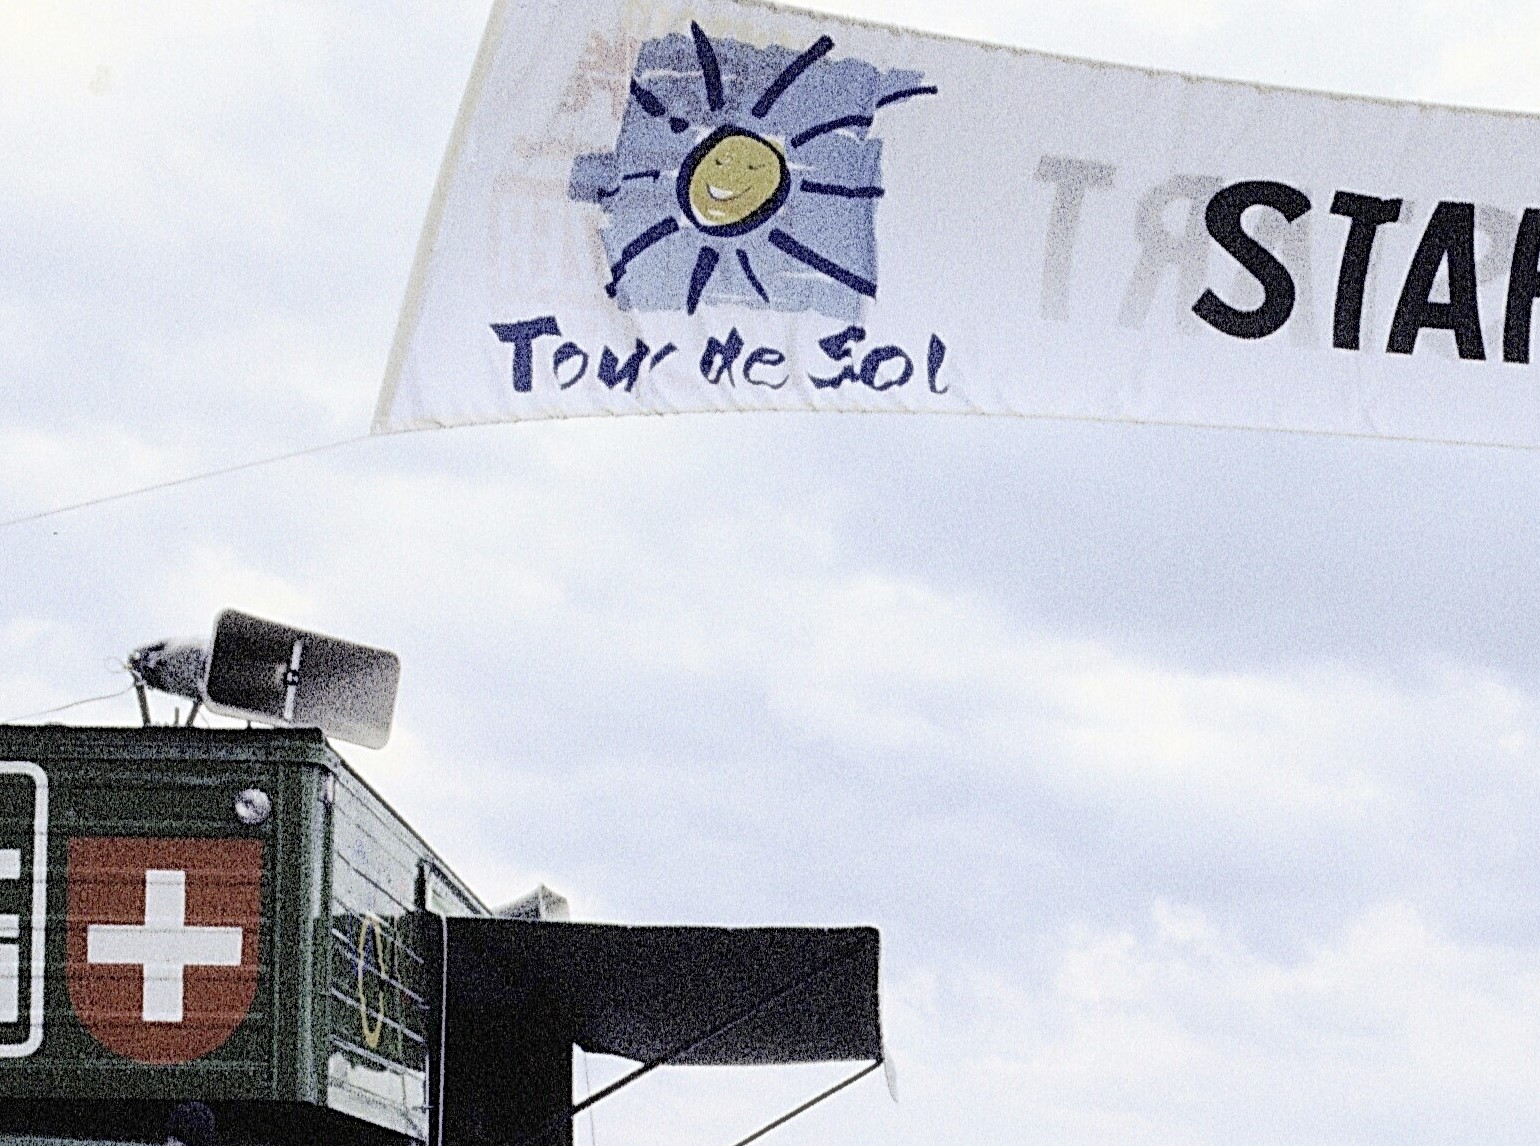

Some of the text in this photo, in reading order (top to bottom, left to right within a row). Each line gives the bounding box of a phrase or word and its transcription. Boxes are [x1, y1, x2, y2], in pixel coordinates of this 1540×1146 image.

[490, 315, 948, 394] Tour de Sol
